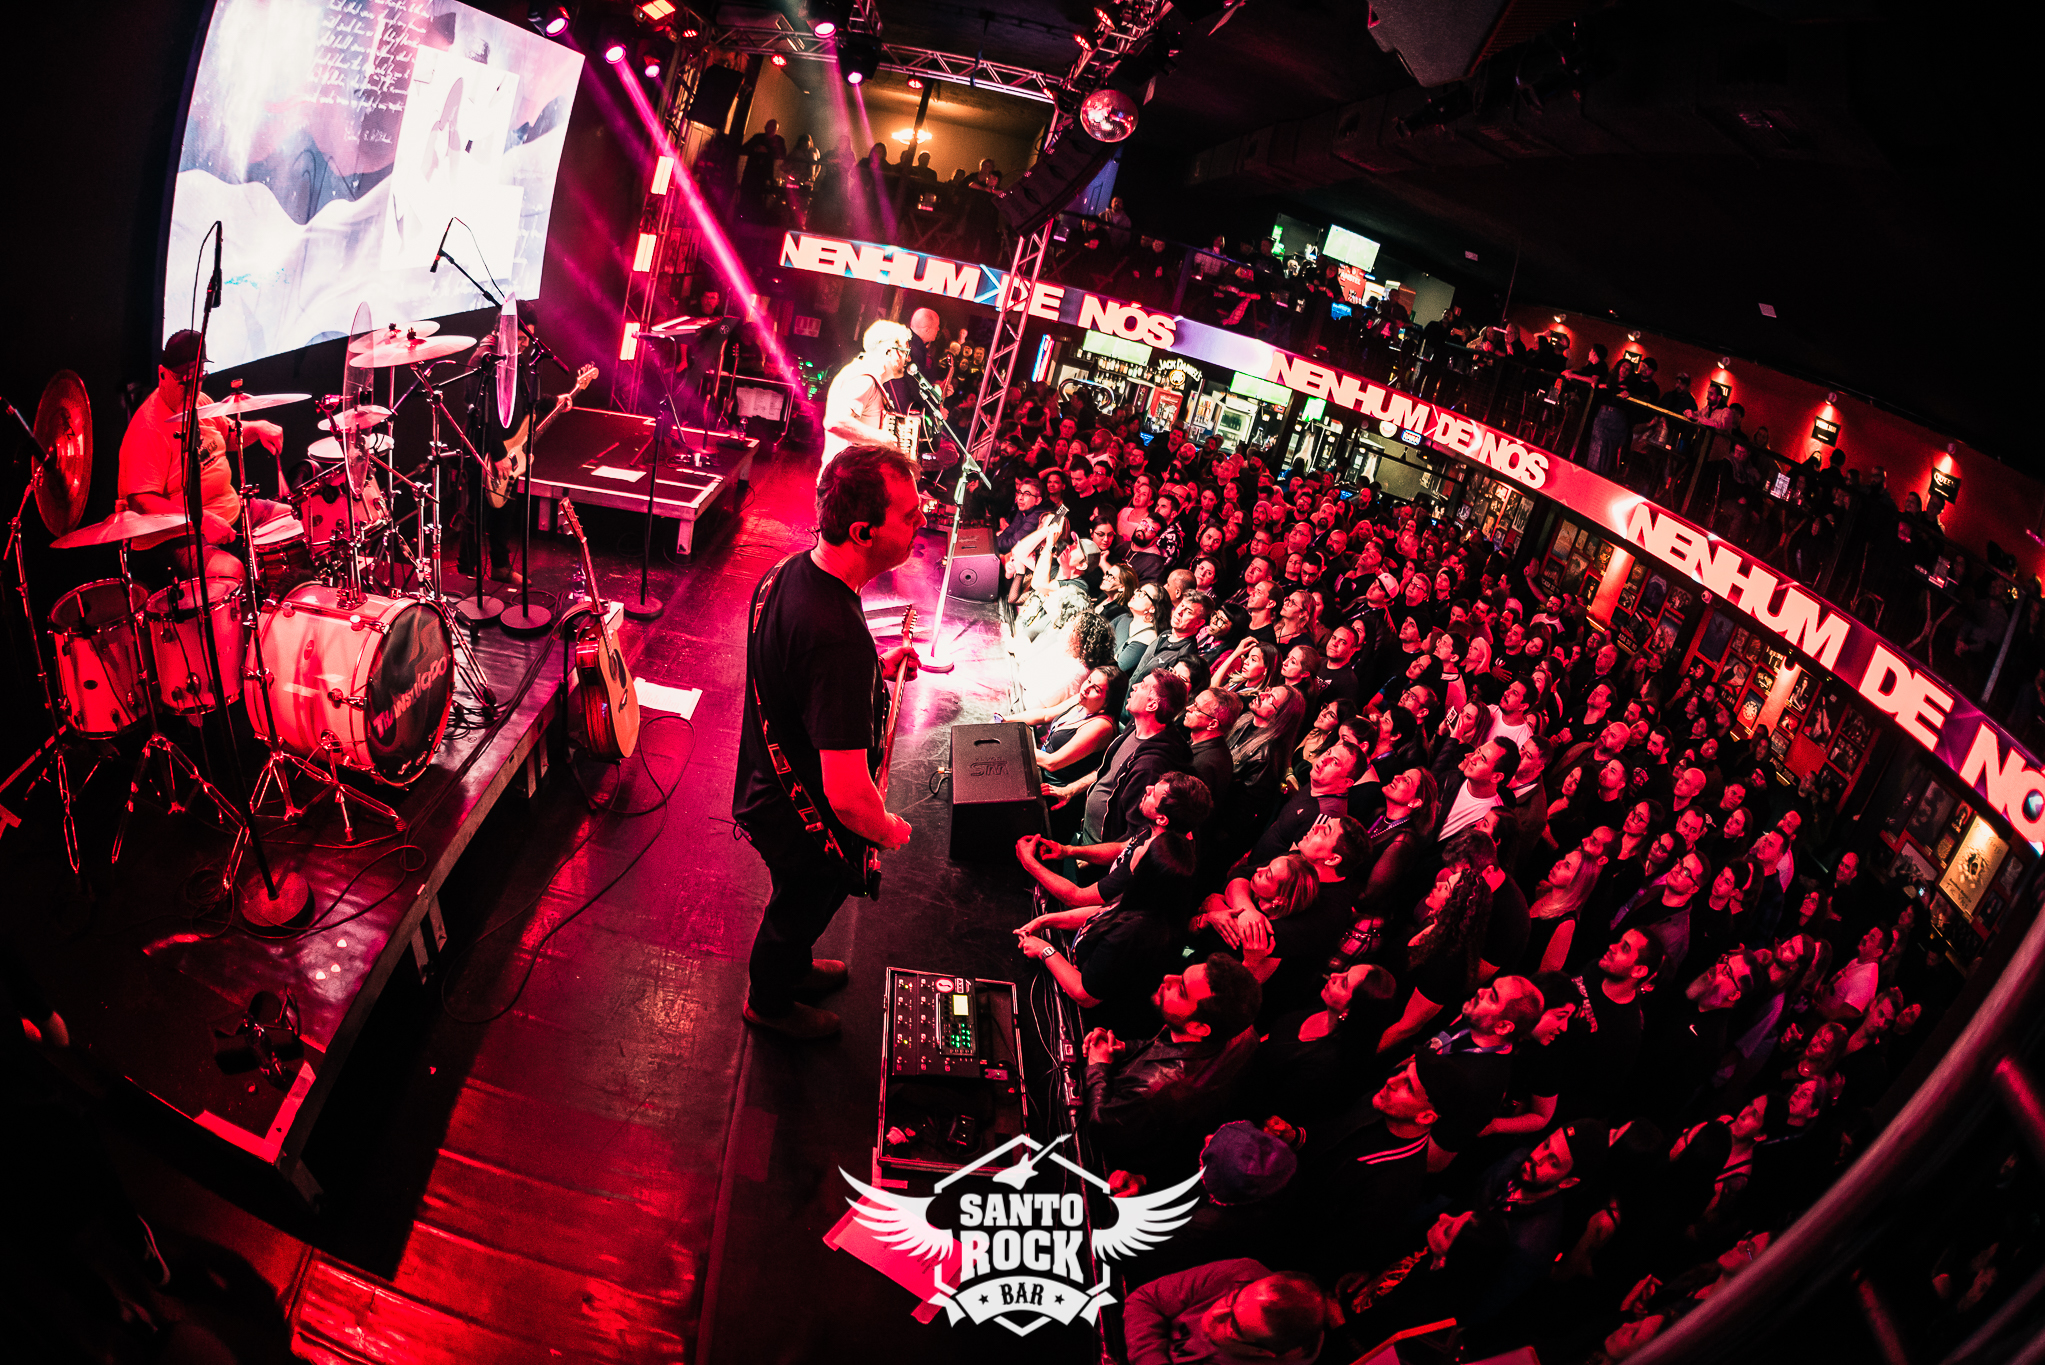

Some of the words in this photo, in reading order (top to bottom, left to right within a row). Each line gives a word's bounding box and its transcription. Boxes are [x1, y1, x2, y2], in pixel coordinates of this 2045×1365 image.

[780, 231, 981, 302] NENHUM
[995, 273, 1066, 321] DE
[1077, 294, 1176, 349] NÓS
[1266, 351, 1430, 434] NENHUM
[1432, 412, 1474, 455] DE
[1478, 431, 1549, 489] NÓS
[1625, 502, 1851, 671] NENHUM
[1858, 643, 1955, 752] DE
